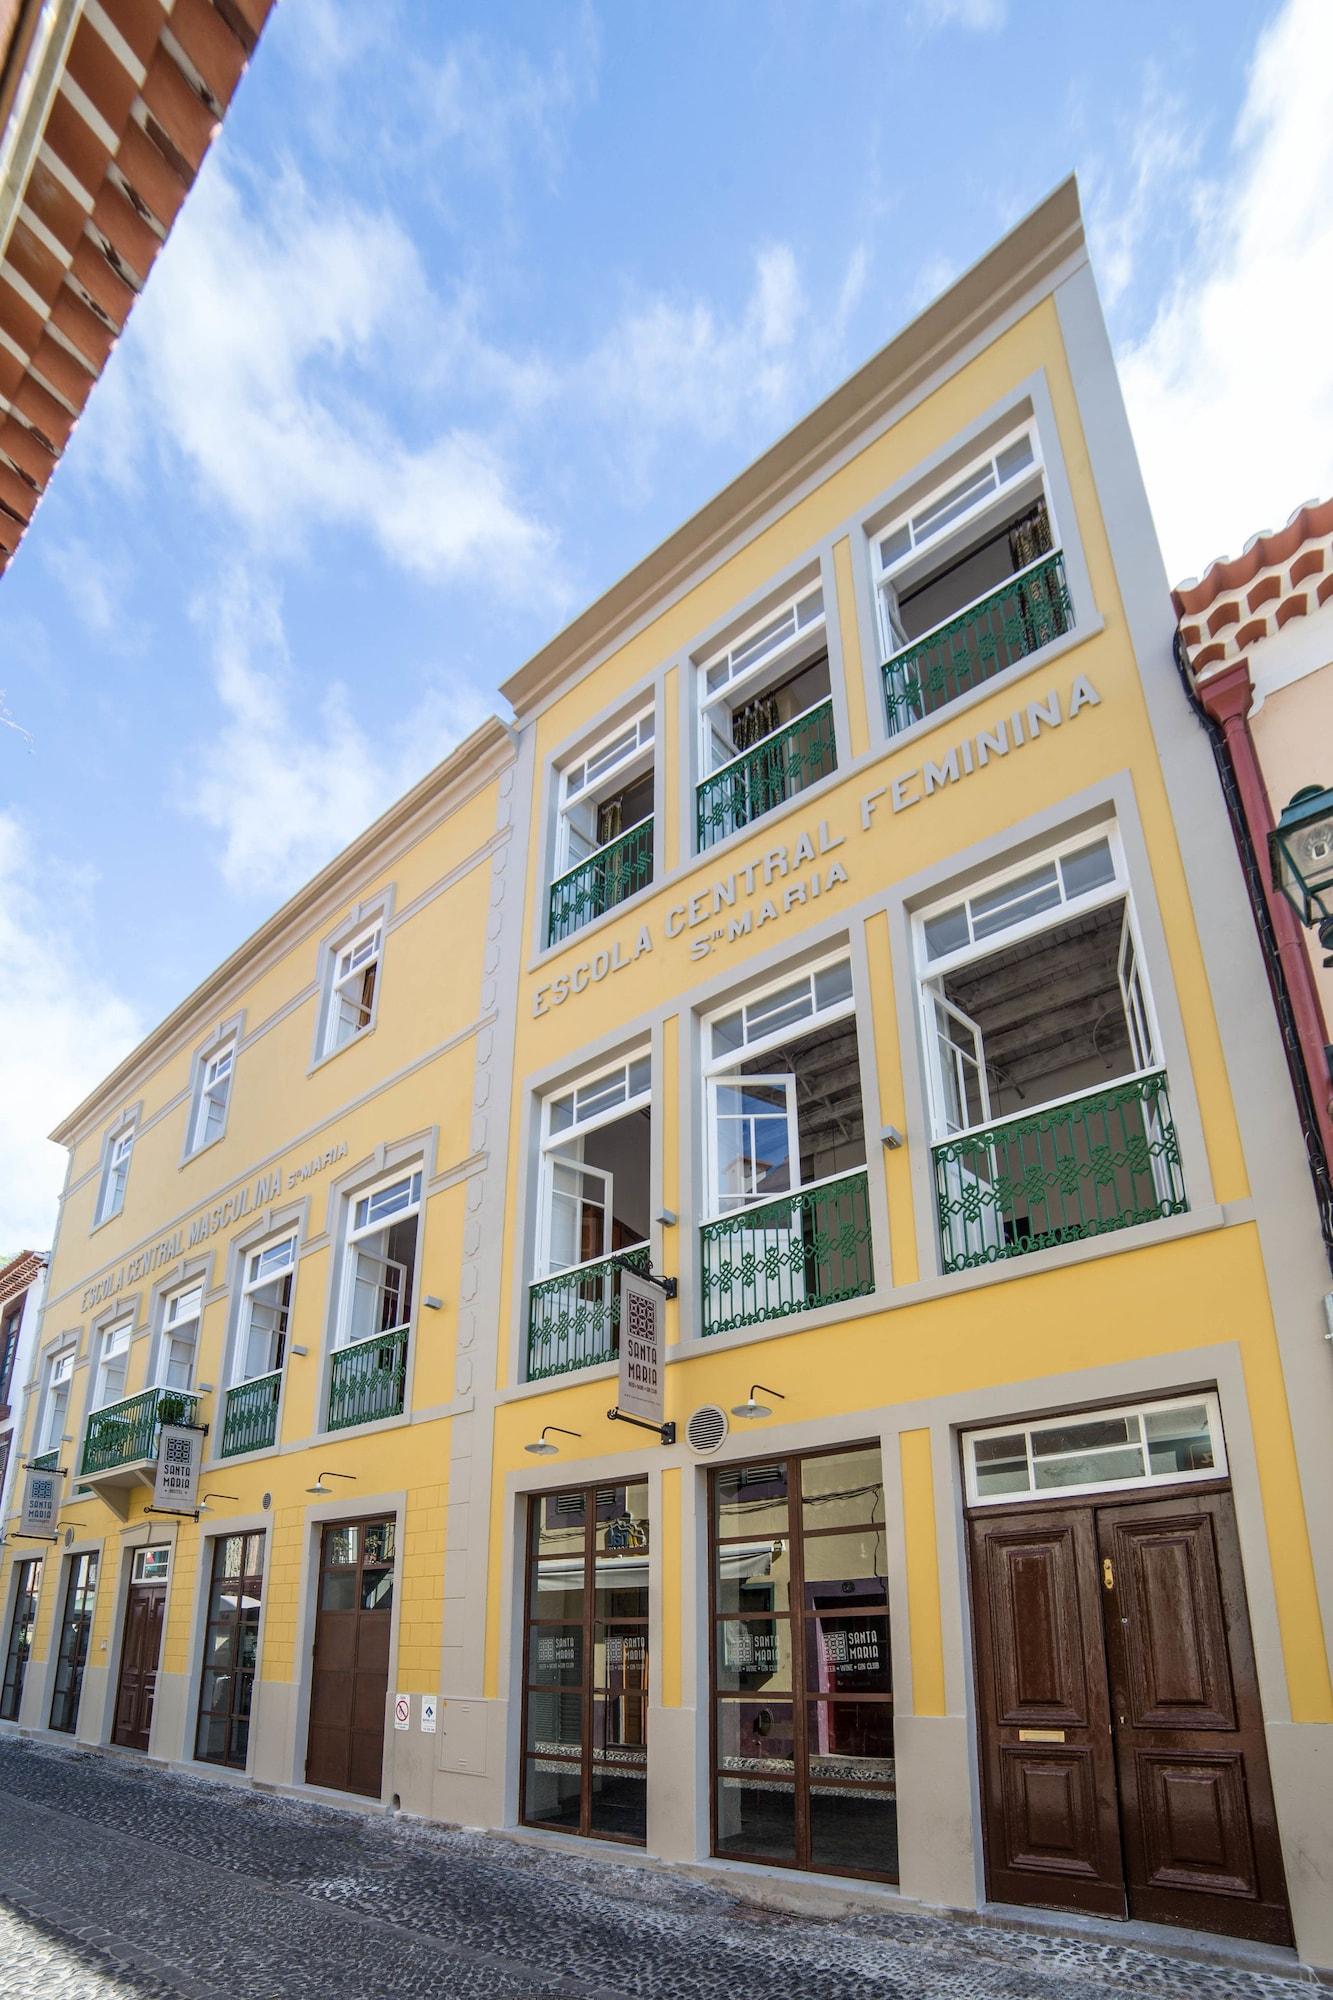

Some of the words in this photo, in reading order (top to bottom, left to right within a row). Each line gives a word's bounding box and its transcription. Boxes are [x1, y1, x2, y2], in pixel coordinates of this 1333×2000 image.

[531, 924, 653, 1019] ESCOLA
[664, 820, 846, 939] CENTRAL
[860, 673, 1101, 832] FEMININA
[727, 862, 849, 944] MARIA
[80, 1266, 124, 1314] ESCOLA
[127, 1230, 184, 1286] CENTRAL
[187, 1167, 282, 1249] MASCULINA
[301, 1141, 348, 1182] MARIA
[628, 1339, 657, 1365] SANTA
[628, 1362, 657, 1386] MARIA
[164, 1464, 190, 1477] SANTA
[163, 1477, 190, 1489] MARIA
[29, 1500, 52, 1510] SANTA
[28, 1510, 51, 1519] MARIA
[555, 1637, 575, 1648] SANTA
[624, 1637, 645, 1648] SANTA
[754, 1635, 779, 1648] SANTA
[848, 1630, 878, 1645] SANTA
[555, 1649, 575, 1660] MARIA
[754, 1648, 779, 1661] MARIA
[849, 1645, 879, 1660] MARIA
